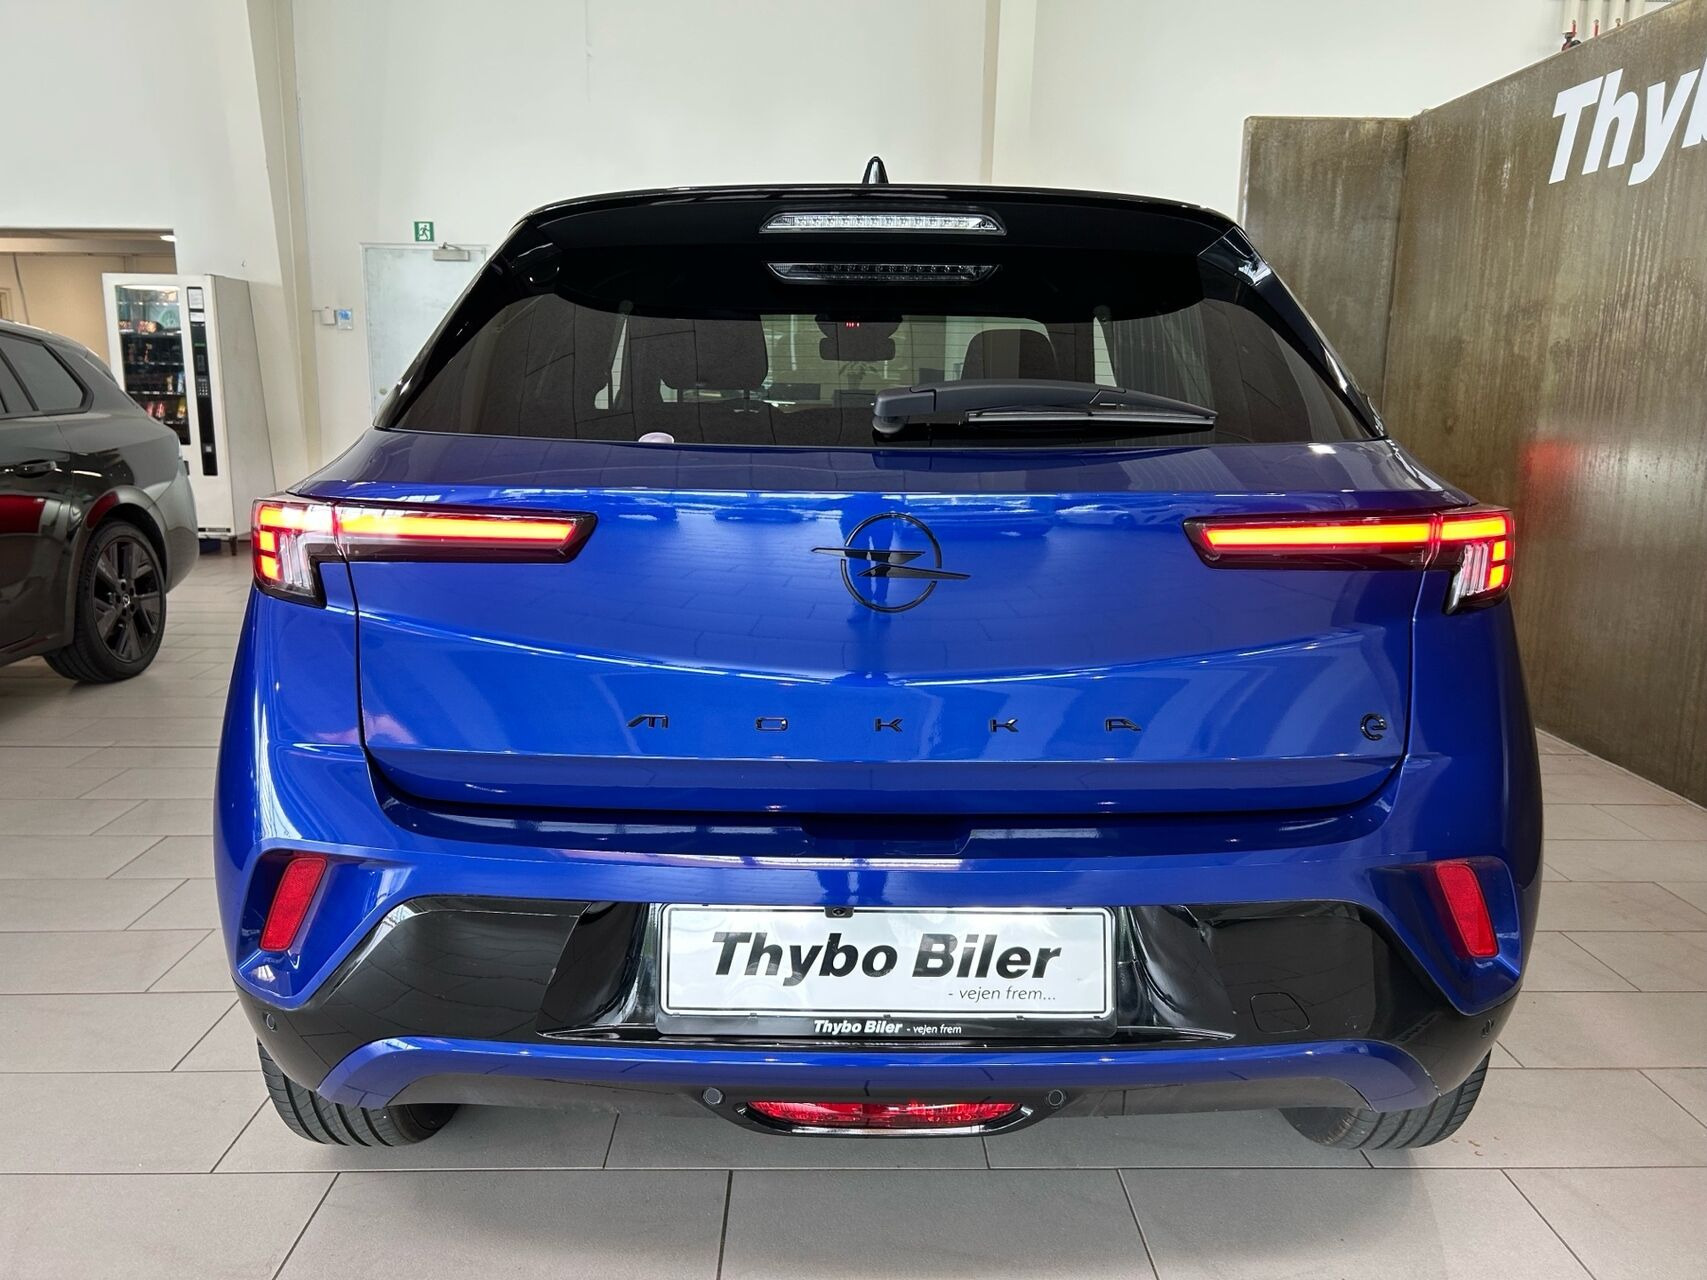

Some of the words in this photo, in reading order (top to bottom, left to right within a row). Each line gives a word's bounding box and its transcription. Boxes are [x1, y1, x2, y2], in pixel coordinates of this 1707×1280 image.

[711, 931, 898, 987] Thybo
[911, 933, 1064, 979] Biler
[959, 986, 1001, 1003] vejen
[1006, 985, 1056, 1000] frem...
[814, 1020, 862, 1035] Thybo
[864, 1020, 903, 1033] Biler
[913, 1025, 938, 1035] vejen
[939, 1024, 962, 1033] frem
